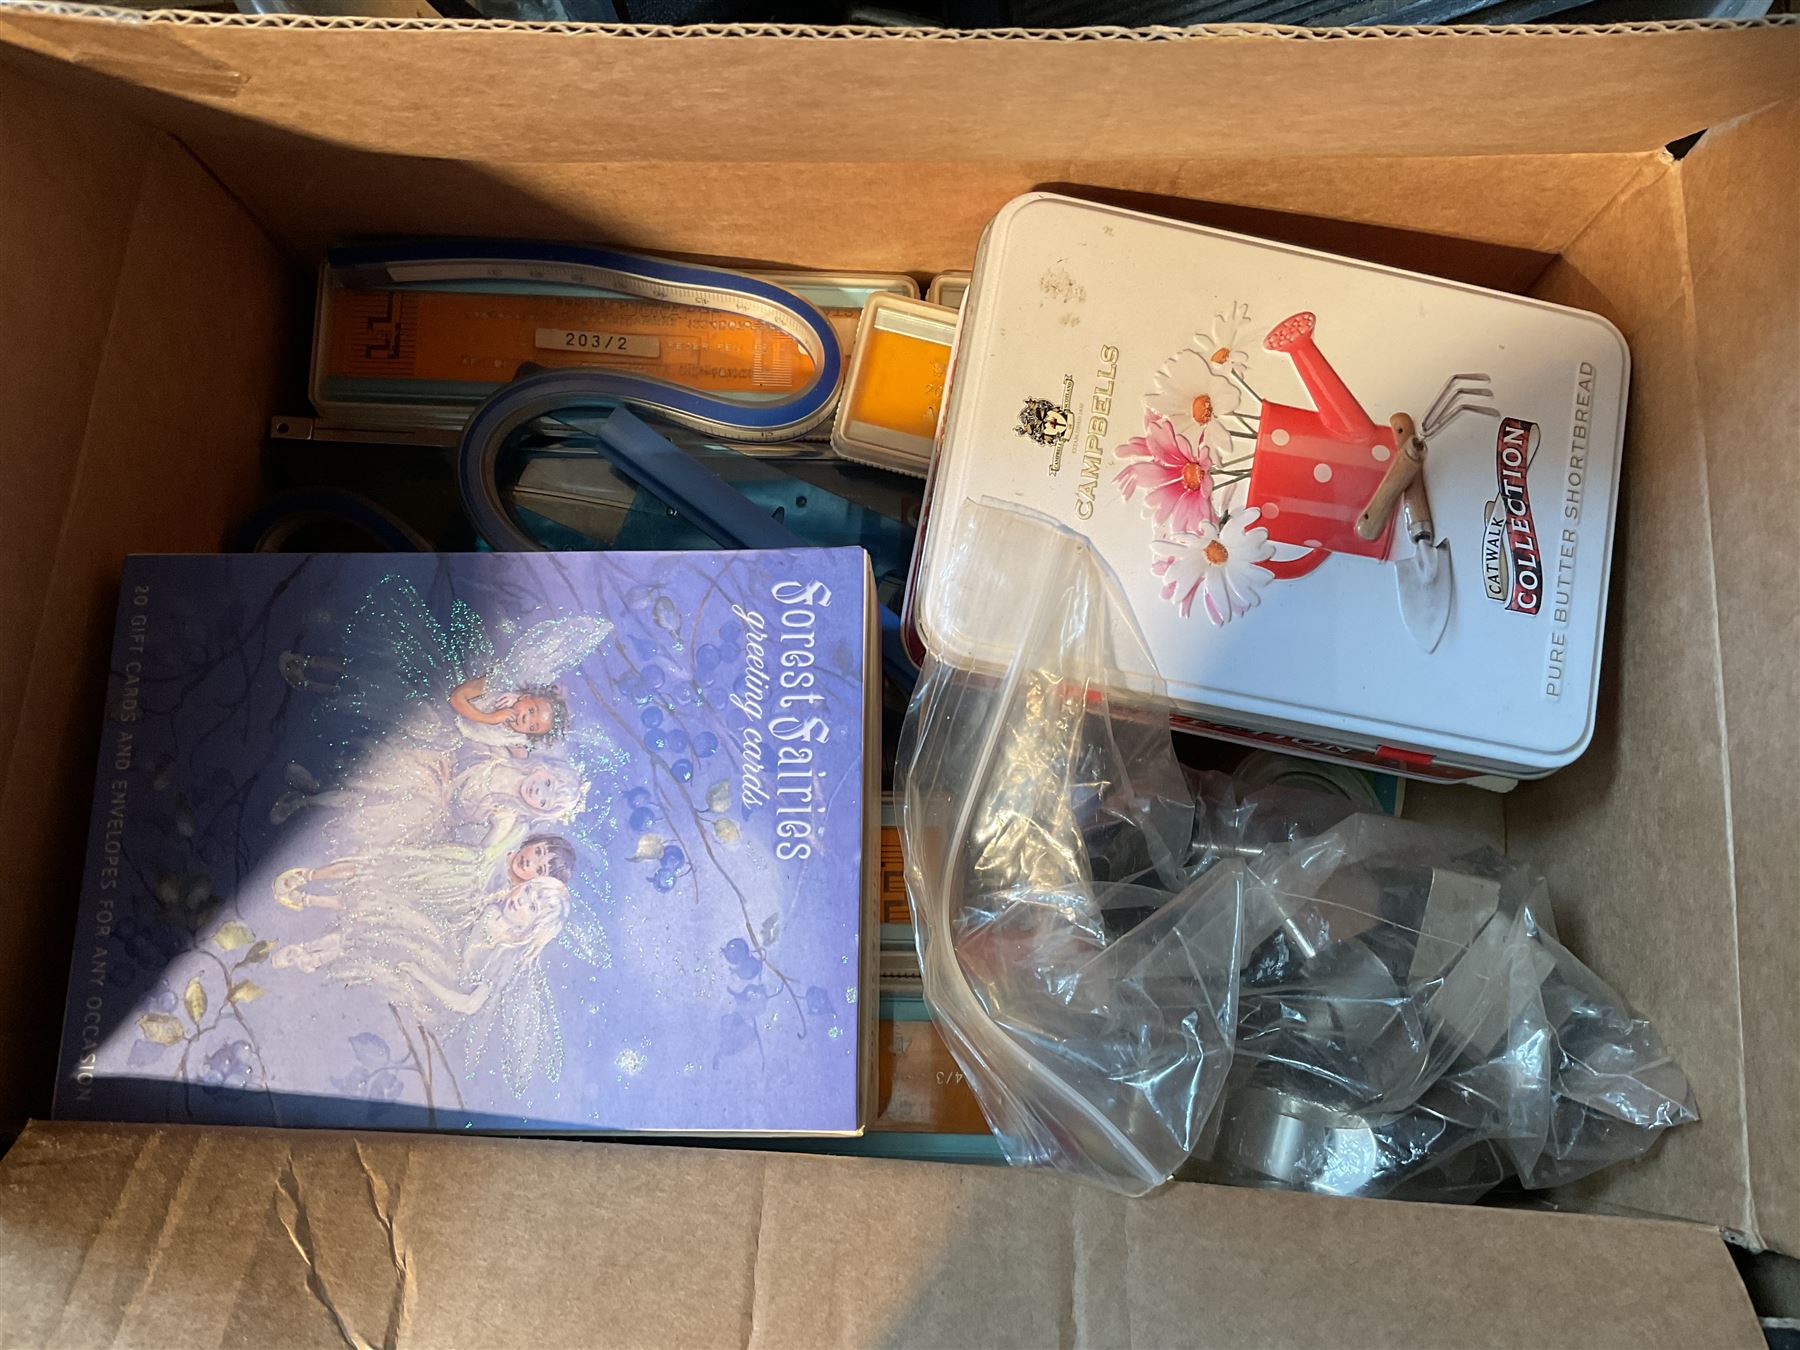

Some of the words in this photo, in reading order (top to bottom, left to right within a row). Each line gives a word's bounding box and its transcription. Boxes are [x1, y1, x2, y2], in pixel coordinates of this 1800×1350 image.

[564, 332, 628, 350] 203/2
[1074, 343, 1119, 521] CAMPBELLS
[1563, 361, 1594, 520] SHORTBREAD
[1486, 516, 1505, 595] CATWALK
[1503, 425, 1539, 610] COLLECTION
[131, 584, 150, 606] 20
[1553, 528, 1576, 623] BUTTER
[127, 614, 148, 653] GIFT
[729, 604, 770, 723] greeting
[770, 579, 832, 709] Forest
[1545, 632, 1566, 698] PURE
[119, 661, 142, 723] CARDS
[114, 730, 134, 770] AND
[741, 727, 770, 810] cards
[767, 715, 831, 861] Fairies
[99, 780, 129, 890] ENVELOPES
[93, 898, 115, 937] FOR
[89, 945, 110, 987] ANY
[74, 995, 104, 1102] OCCASION
